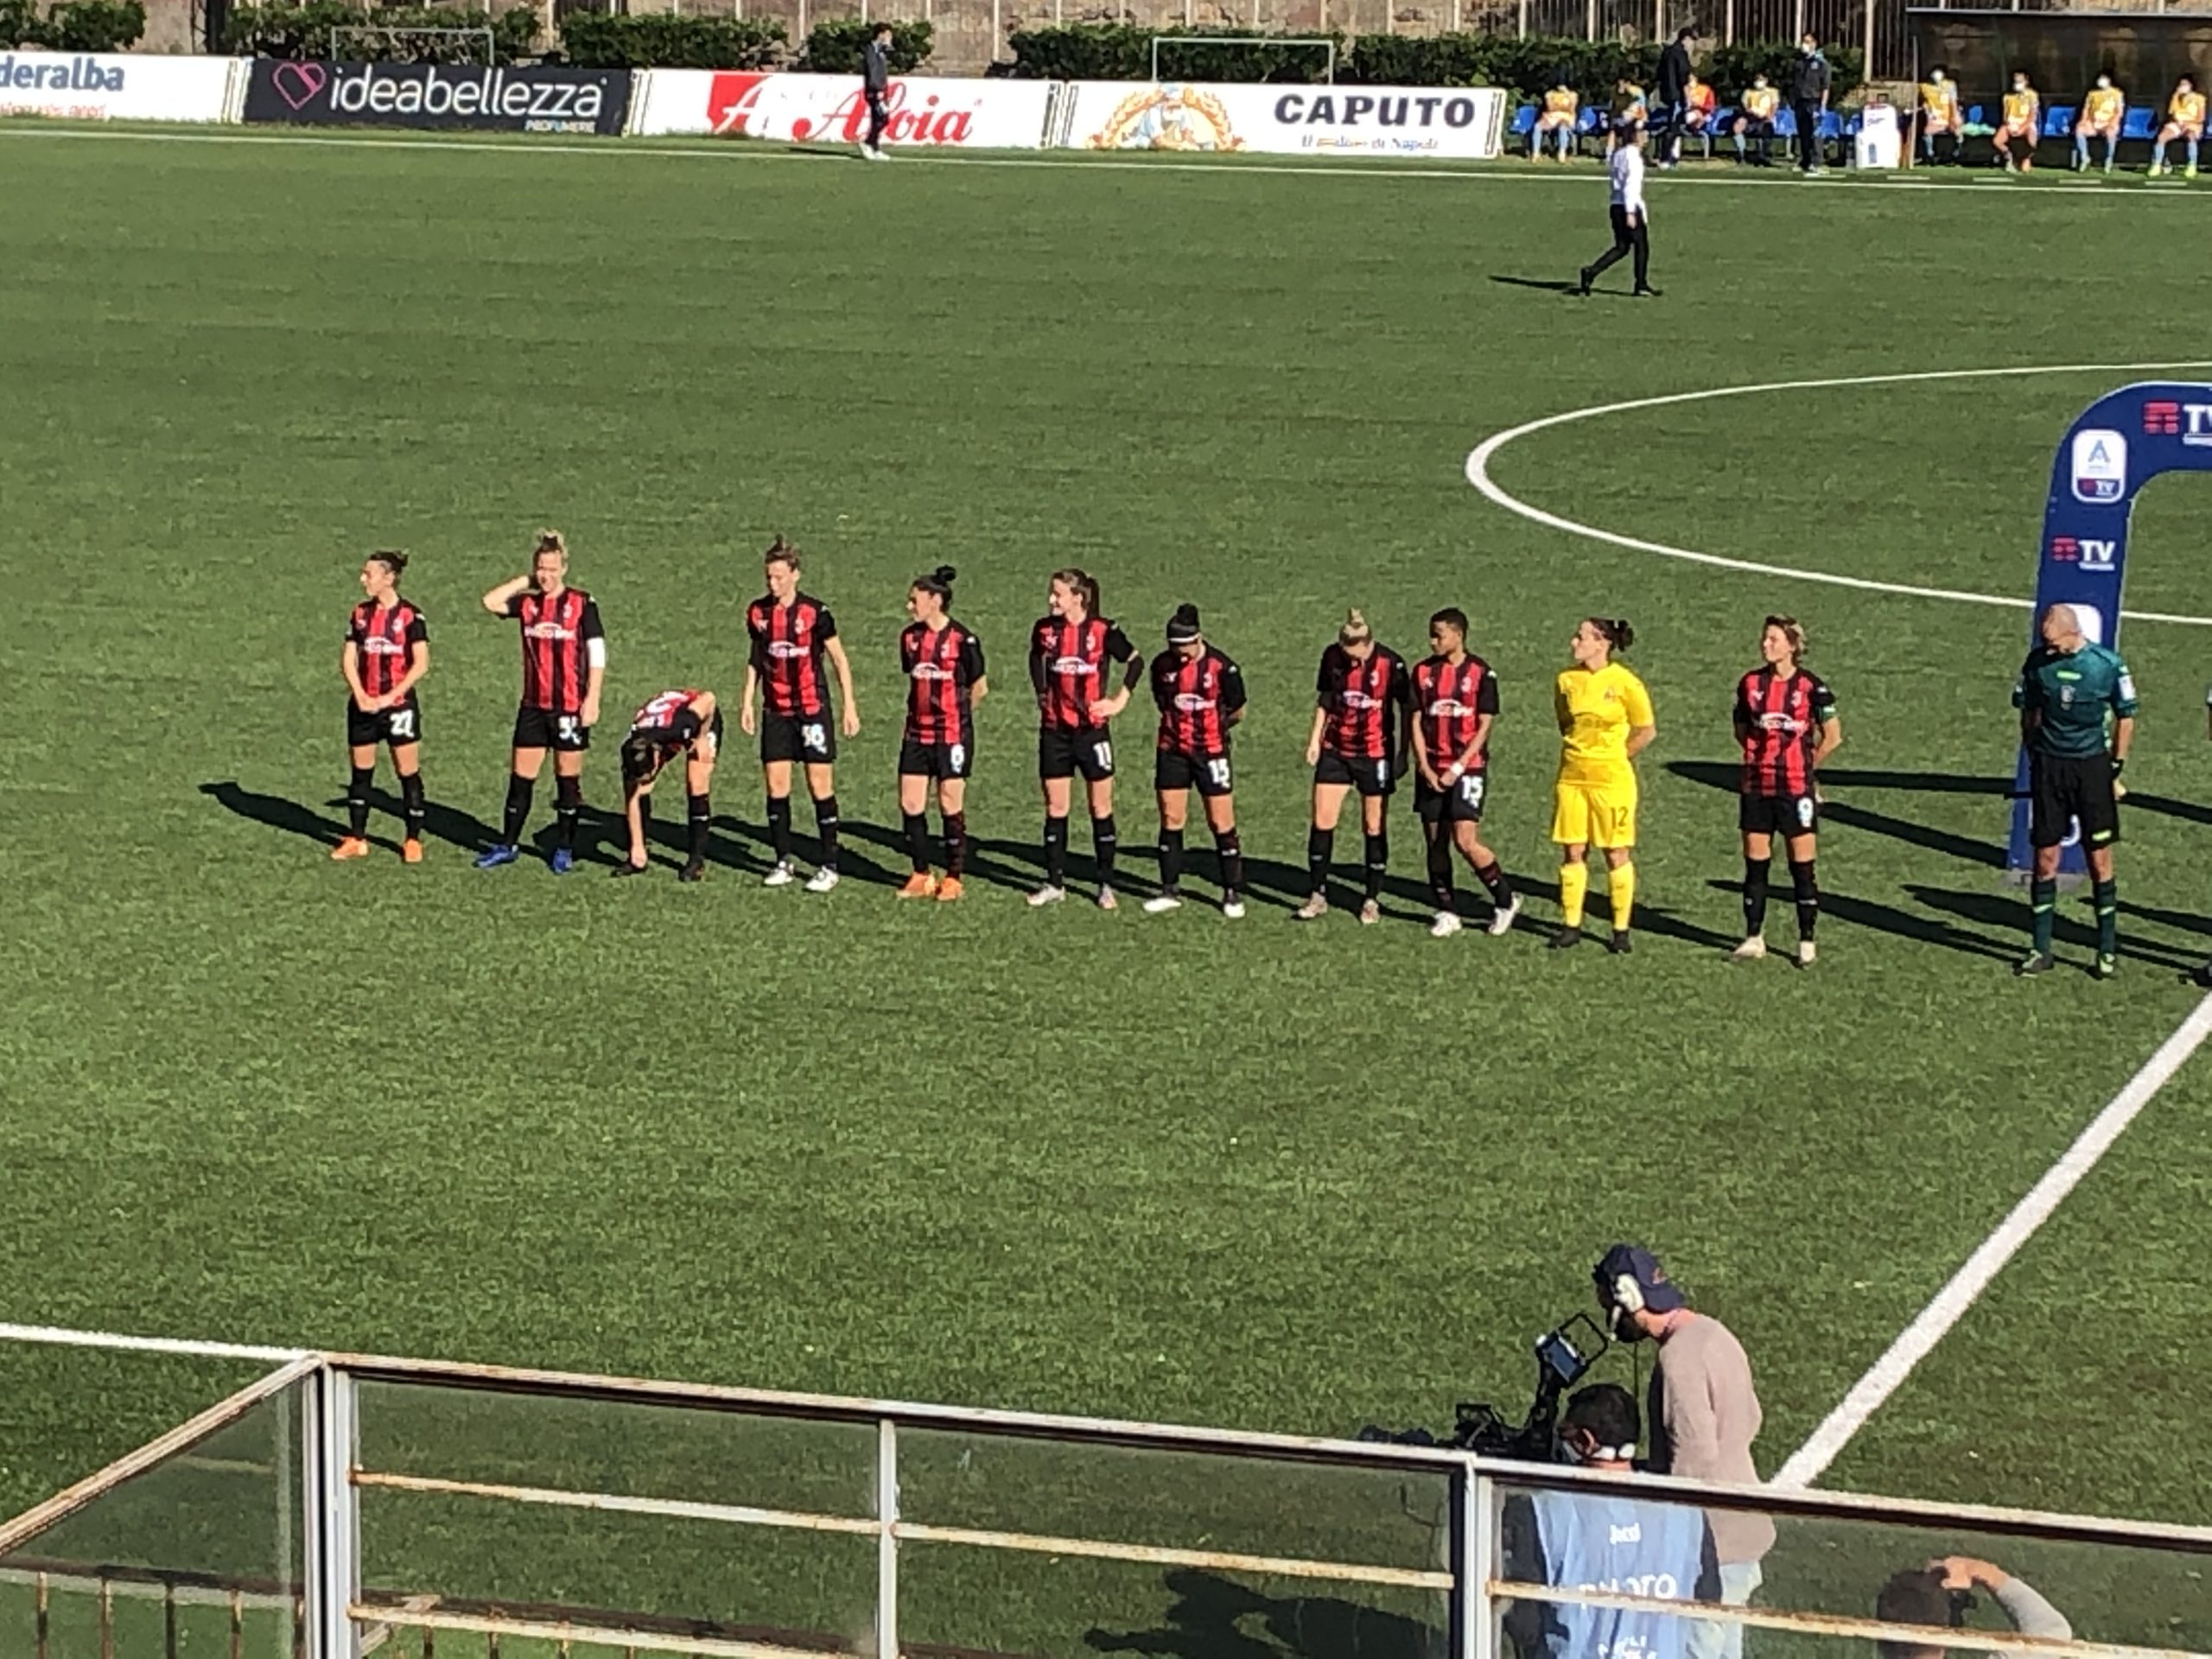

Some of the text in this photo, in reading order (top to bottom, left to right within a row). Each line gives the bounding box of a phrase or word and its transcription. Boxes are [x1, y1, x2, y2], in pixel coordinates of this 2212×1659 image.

[0, 54, 125, 92] deralba
[329, 63, 601, 117] ideabellezza
[1274, 93, 1475, 128] CAPUTO
[2078, 540, 2115, 561] TV
[1611, 805, 1629, 830] 12
